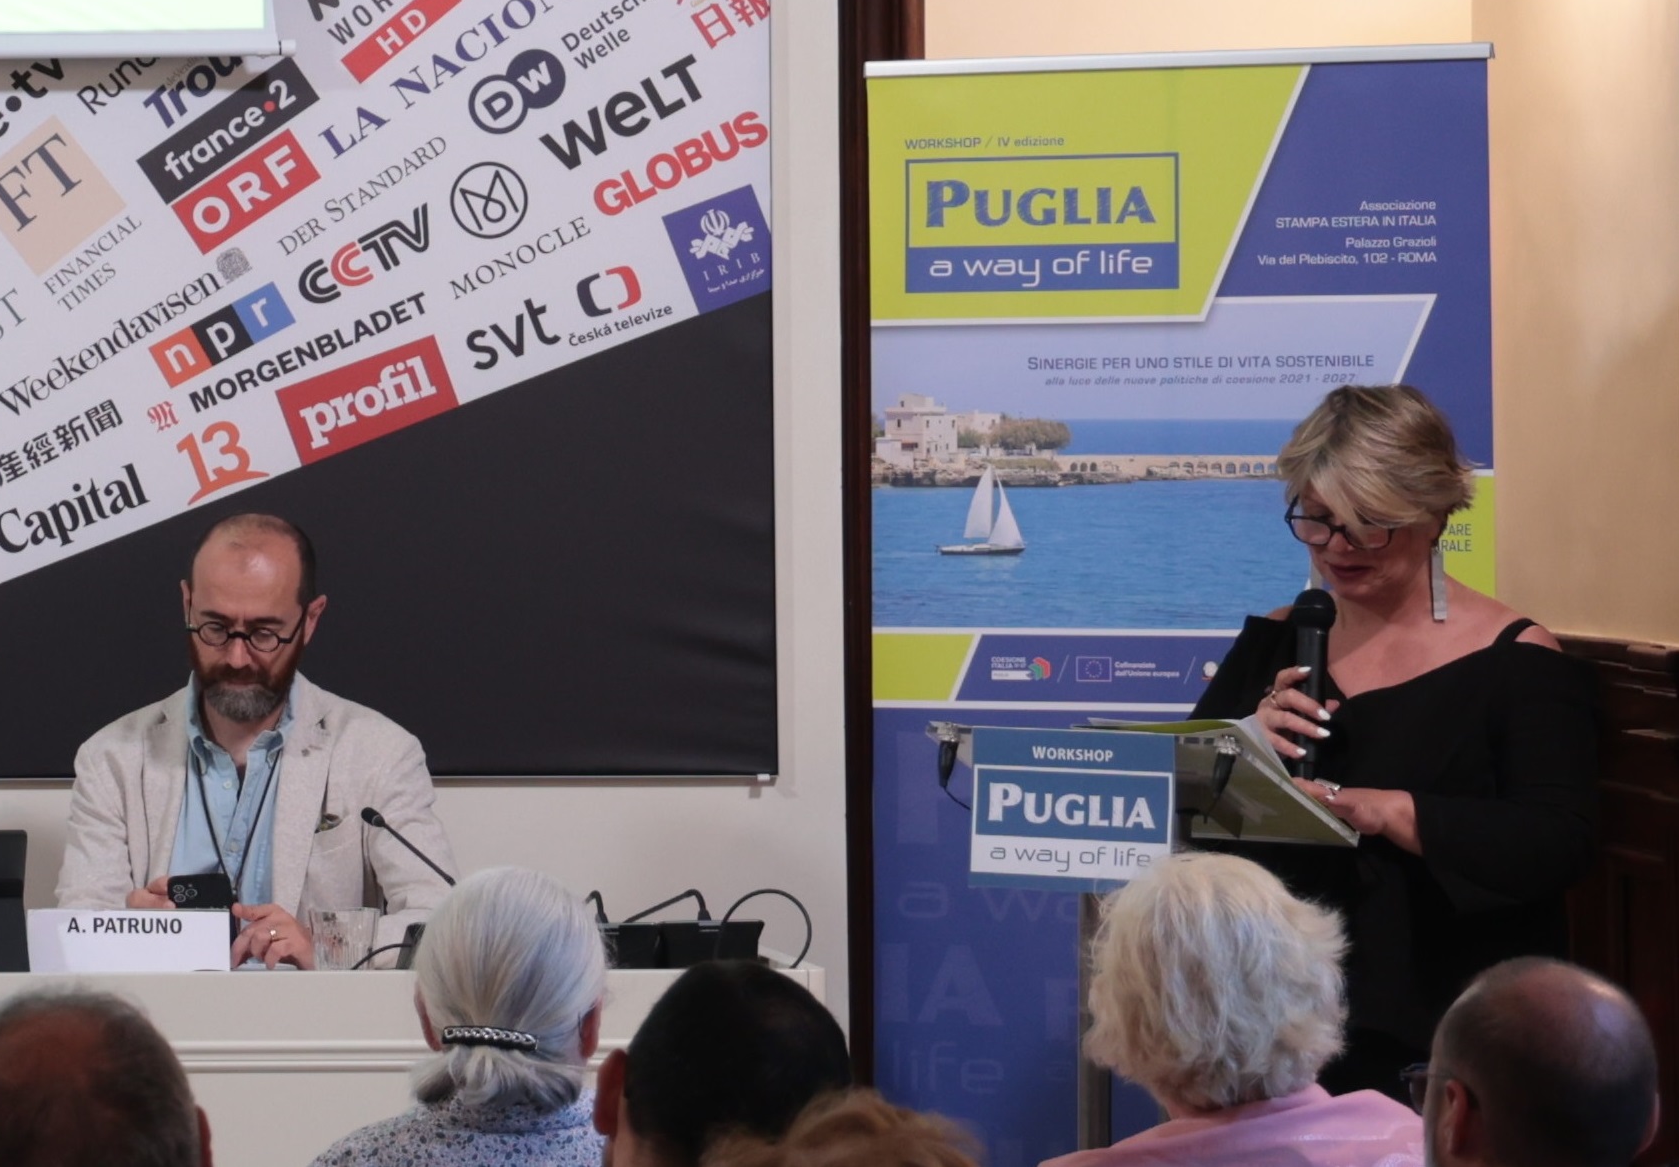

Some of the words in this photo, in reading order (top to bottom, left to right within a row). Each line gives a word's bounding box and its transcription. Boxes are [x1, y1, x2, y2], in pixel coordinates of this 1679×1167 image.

[573, 25, 632, 71] Welle
[318, 106, 391, 160] LA
[904, 137, 982, 151] WORKSHOP
[1014, 135, 1065, 148] edizione
[189, 143, 305, 235] ORF
[323, 133, 448, 226] STANDARD
[591, 110, 770, 218] GLOBUS
[925, 179, 1157, 228] PUGLIA
[1359, 199, 1436, 212] Associazione
[43, 214, 143, 297] FINANCIAL
[297, 200, 432, 306] CCTV
[448, 216, 594, 302] MONOCLE
[930, 258, 953, 277] a
[963, 256, 1040, 287] way
[1052, 251, 1090, 276] of
[1099, 250, 1153, 275] life
[56, 262, 119, 315] TIMES
[188, 291, 428, 414] MORGENBLADET
[464, 296, 563, 371] svt
[1027, 356, 1098, 372] SINERGIE
[1102, 356, 1131, 370] PER
[1135, 356, 1169, 370] UNO
[1173, 356, 1214, 369] STILE
[1237, 355, 1272, 368] VITA
[1275, 354, 1375, 368] SOSTENIBILE
[298, 355, 438, 450] profil
[1032, 745, 1114, 763] WORKSHOP
[987, 782, 1157, 830] PUGLIA
[1014, 846, 1070, 873] way
[1079, 846, 1109, 866] of
[1113, 847, 1151, 868] life
[66, 916, 87, 934] A.
[92, 916, 183, 935] PATRUNO
